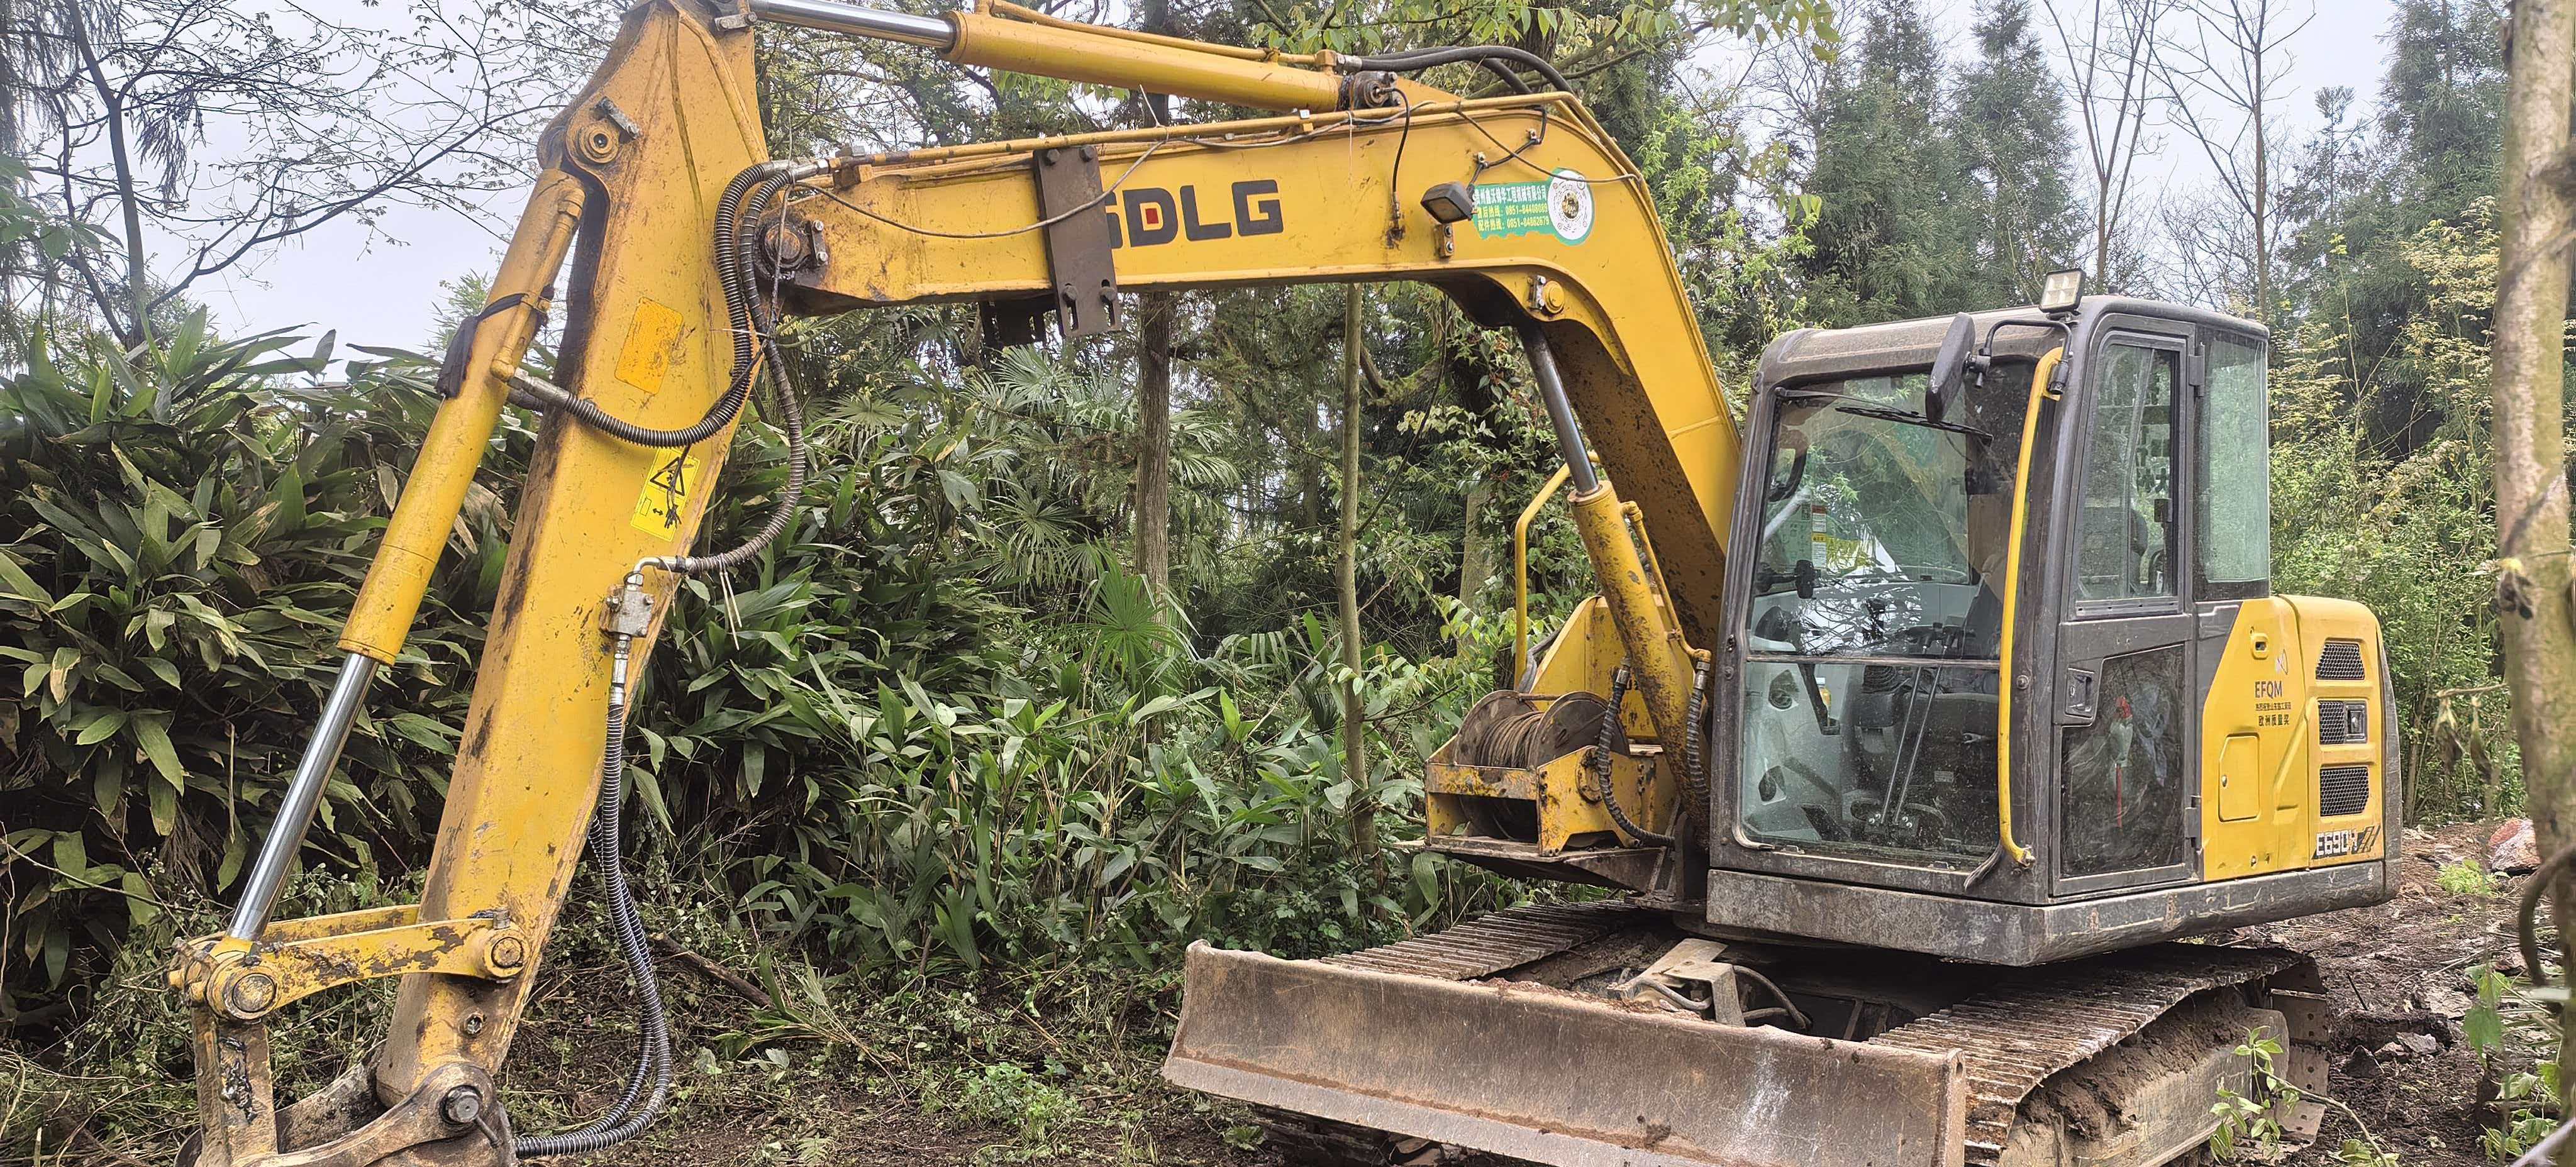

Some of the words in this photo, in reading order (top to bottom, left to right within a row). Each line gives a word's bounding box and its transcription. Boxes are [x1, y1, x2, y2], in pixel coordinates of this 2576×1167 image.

[2255, 680, 2282, 699] EFQM
[2258, 714, 2289, 726] 欧洲质量奖
